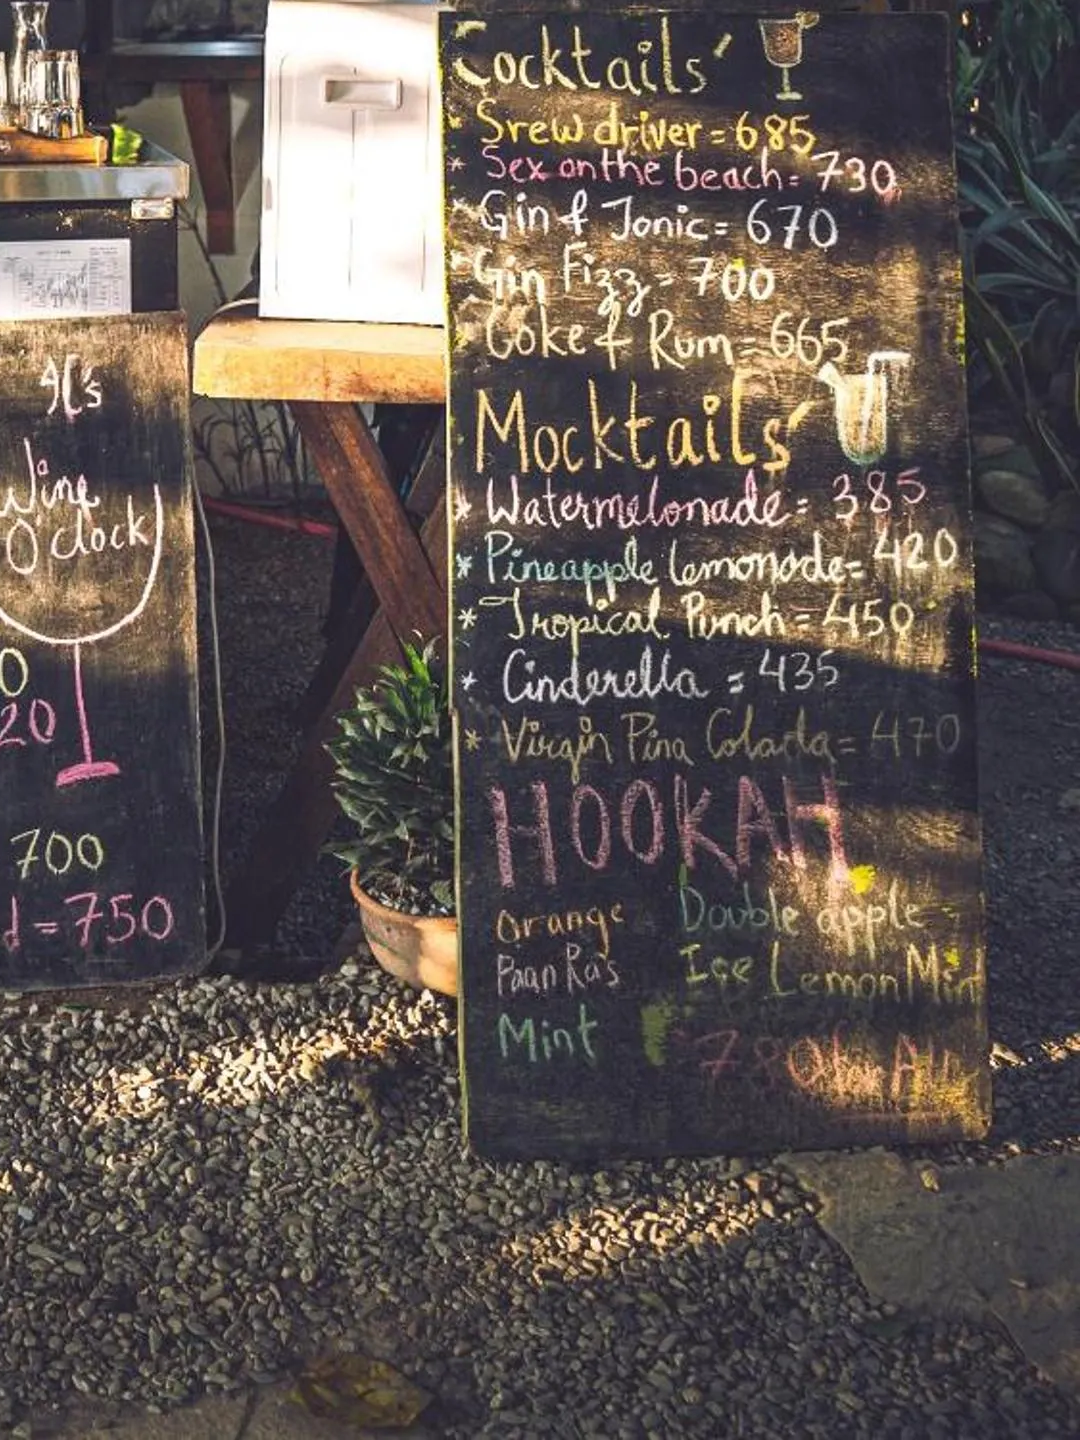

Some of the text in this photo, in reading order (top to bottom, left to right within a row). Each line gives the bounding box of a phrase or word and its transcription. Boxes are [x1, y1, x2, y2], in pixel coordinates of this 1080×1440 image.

[593, 101, 703, 153] driver
[734, 112, 820, 155] 685
[481, 145, 549, 184] Sex
[674, 146, 786, 194] beach
[810, 151, 897, 196] 730
[479, 189, 550, 241] Gin
[746, 198, 839, 251] 670
[562, 241, 653, 318] Fizz
[686, 258, 777, 302] 700
[648, 307, 735, 369] Rum
[770, 311, 851, 363] 665
[485, 468, 928, 531] Watermelonade 385
[483, 529, 657, 605] Pineapple
[872, 527, 960, 573] 420
[681, 589, 787, 641] Punch
[820, 597, 915, 640] 450
[501, 644, 840, 707] Cinderella 435
[501, 714, 614, 786] Virgin
[872, 709, 962, 758] 470
[9, 827, 106, 882] 700
[487, 771, 850, 890] HOOKAH
[63, 891, 176, 952] 750
[678, 866, 802, 936] Double
[496, 1002, 599, 1063] Mint
